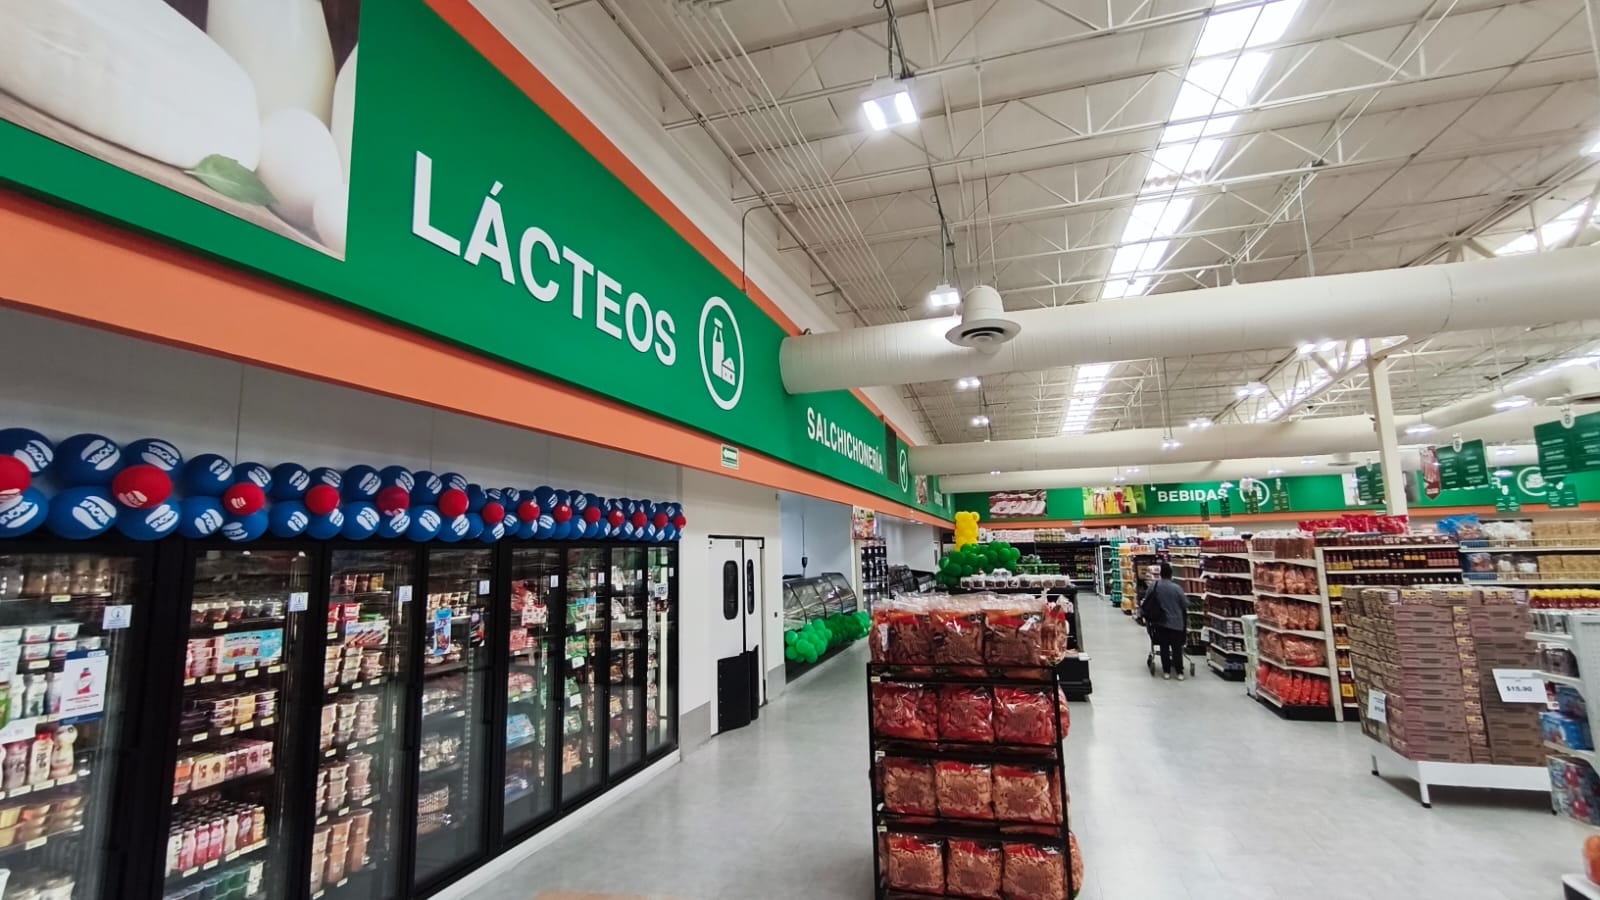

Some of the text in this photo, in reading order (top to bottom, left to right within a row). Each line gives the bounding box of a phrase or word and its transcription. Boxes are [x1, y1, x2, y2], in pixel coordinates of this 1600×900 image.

[412, 150, 677, 366] LÁCTEOS
[807, 406, 884, 475] SALCHICHONERÍA
[26, 443, 48, 469] YAQUI
[88, 443, 114, 465] YAQUI
[1158, 488, 1228, 502] BEBIDAS
[80, 499, 108, 525] YAQUI
